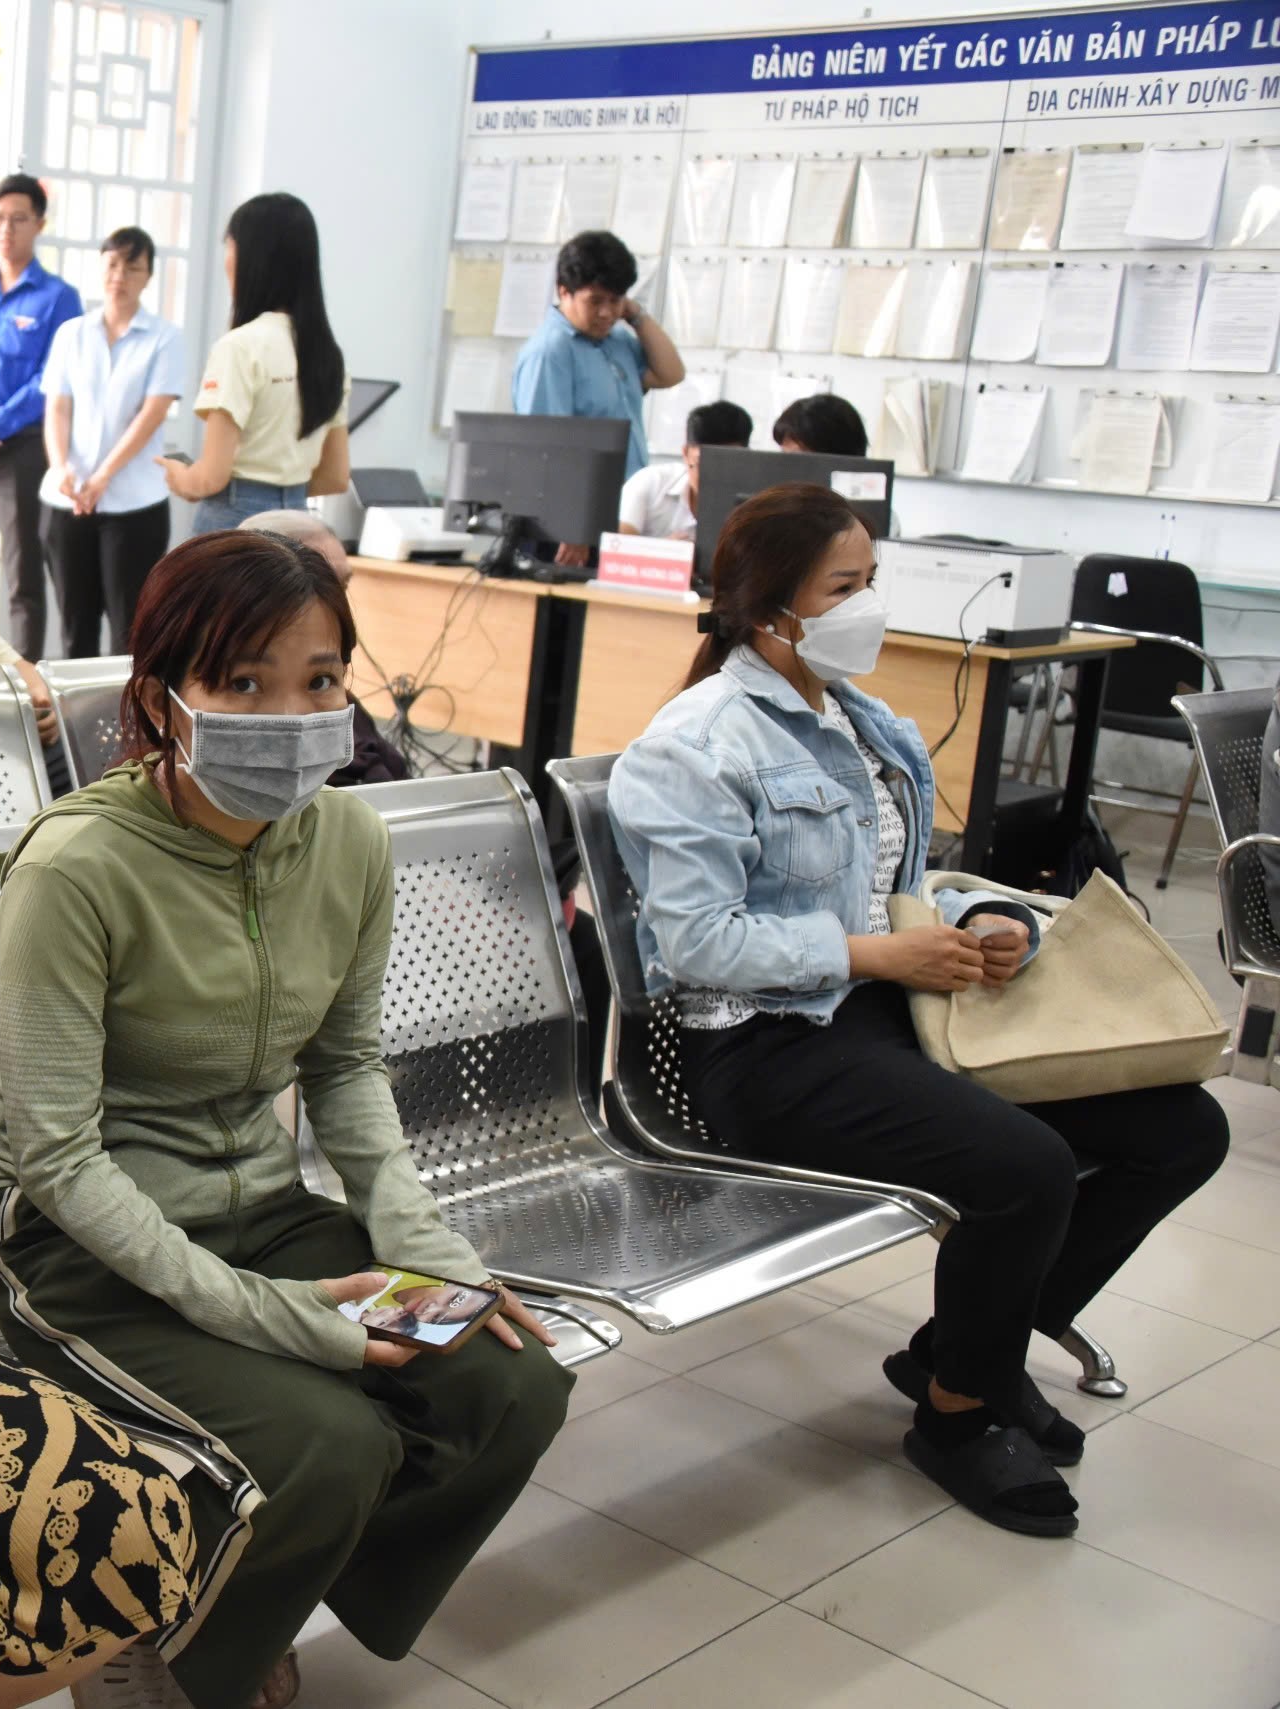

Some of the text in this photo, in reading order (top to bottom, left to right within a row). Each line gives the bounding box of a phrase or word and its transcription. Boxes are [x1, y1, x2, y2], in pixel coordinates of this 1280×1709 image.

[751, 43, 816, 80] BẢNG
[823, 42, 888, 76] NIÊM
[898, 33, 947, 72] YẾT
[954, 33, 1008, 69] CÁC
[1019, 29, 1074, 65] VĂN
[1085, 20, 1146, 62] BẢN
[1155, 15, 1241, 57] PHÁP
[879, 95, 919, 120] TỊCH
[1027, 90, 1058, 116] ĐỊA
[476, 111, 499, 130] LAO
[597, 106, 628, 127] BINH
